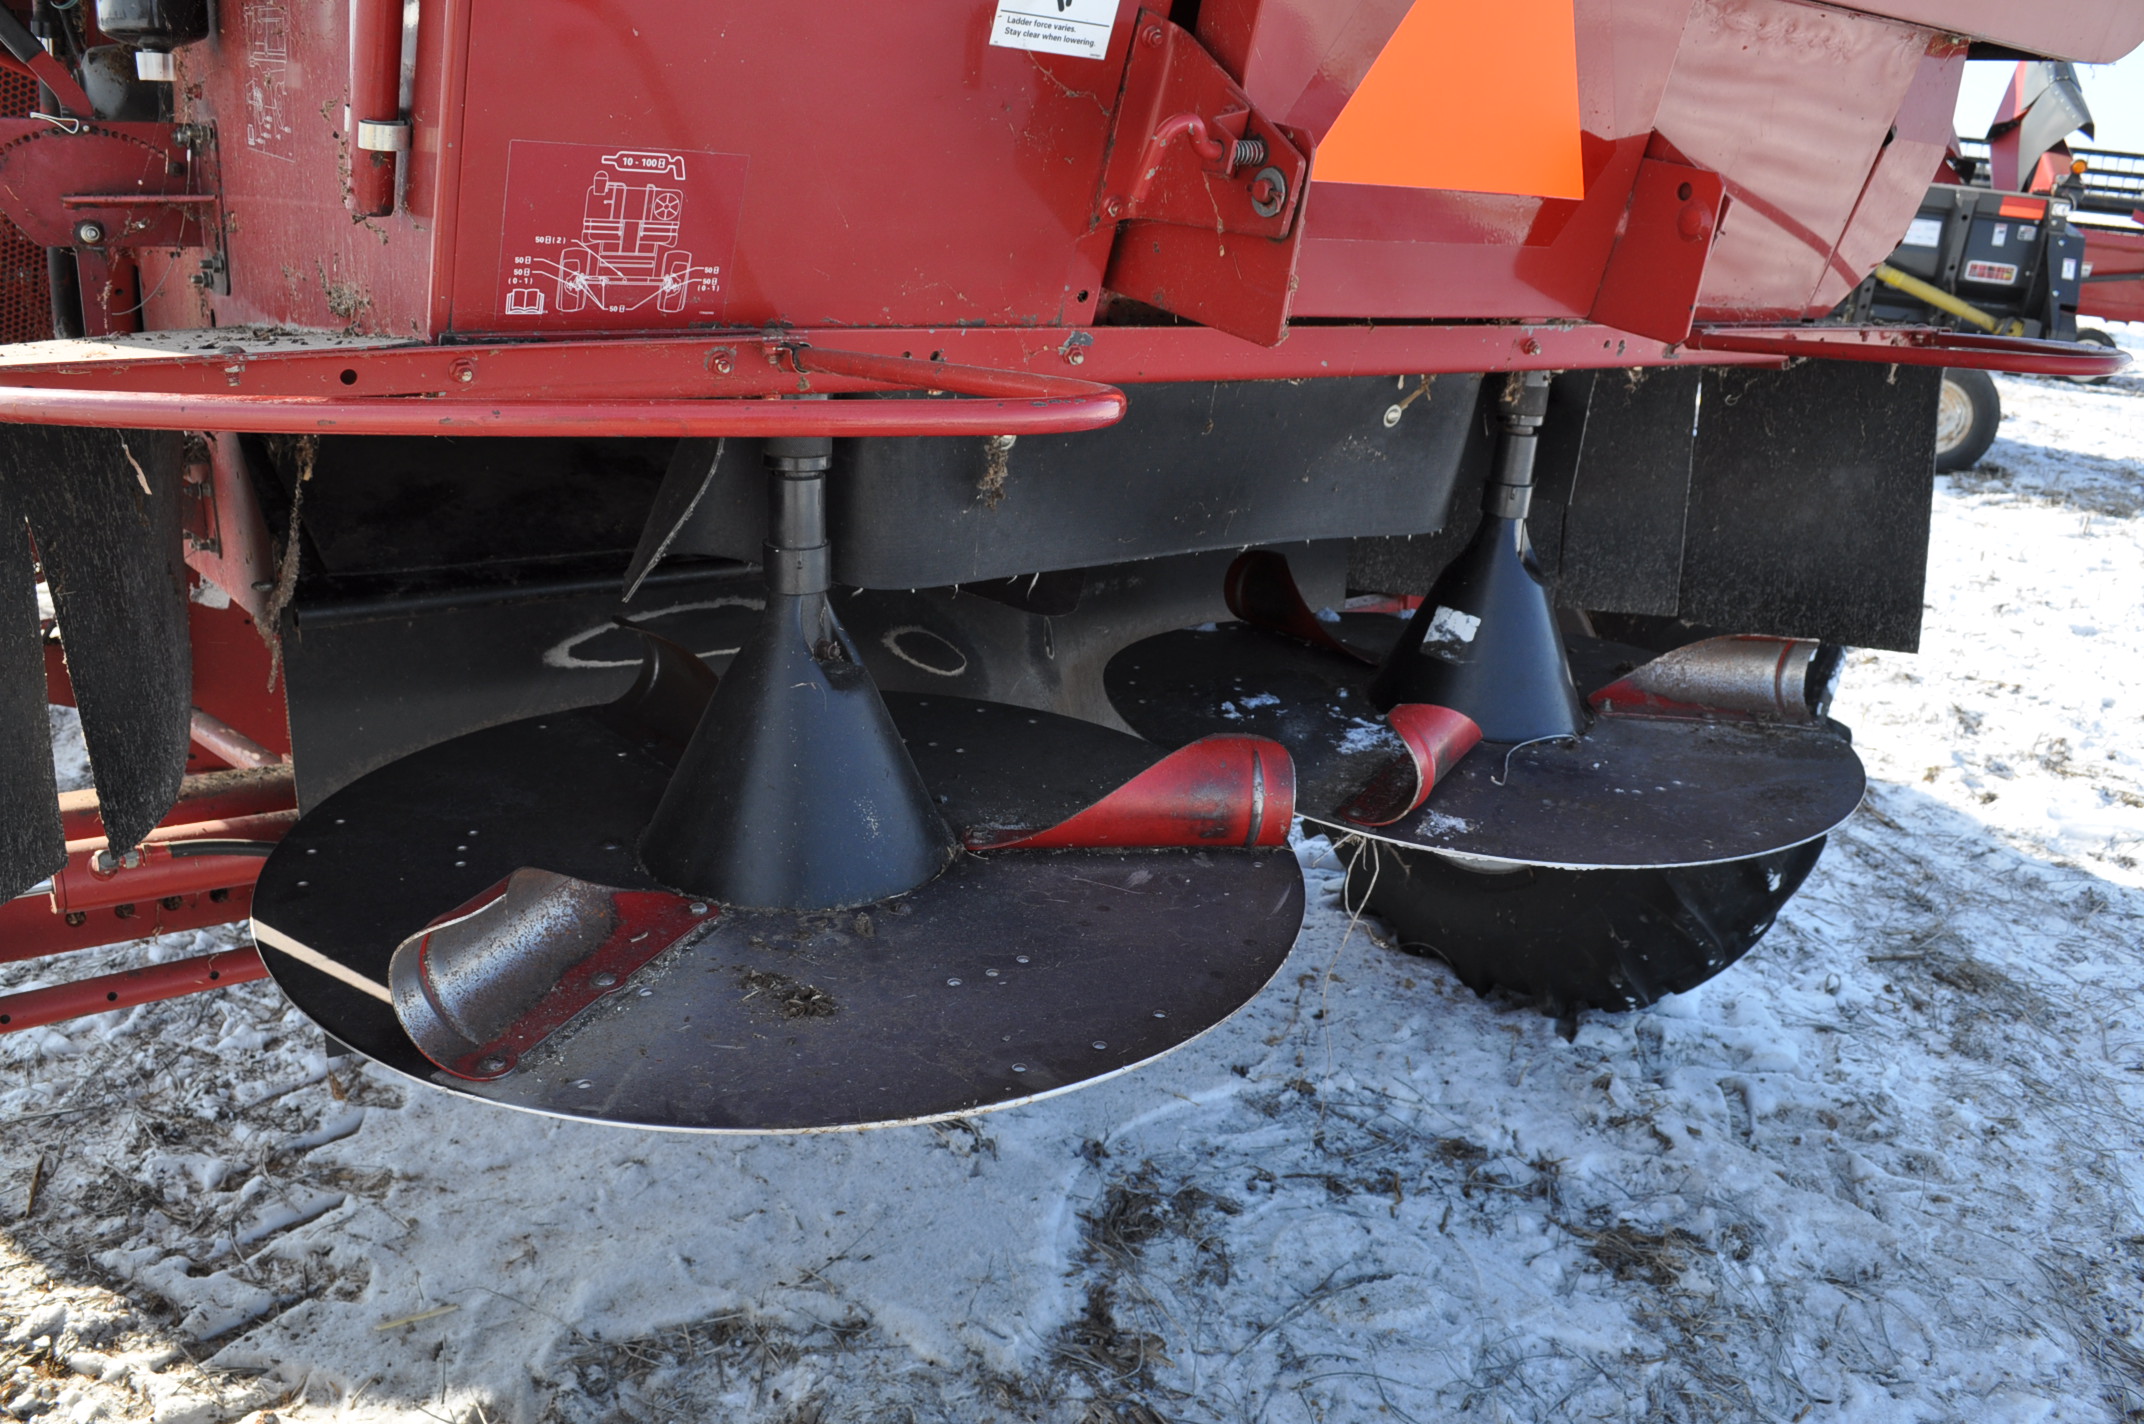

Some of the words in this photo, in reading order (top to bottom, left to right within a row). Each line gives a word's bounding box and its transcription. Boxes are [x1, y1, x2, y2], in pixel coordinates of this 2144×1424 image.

[1007, 16, 1032, 26] Ladder
[1033, 21, 1051, 29] force
[1053, 24, 1076, 33] varies.
[1004, 27, 1021, 37] Stay
[1022, 29, 1040, 39] clear
[1042, 33, 1062, 42] when
[1063, 36, 1096, 48] lowering.
[622, 157, 634, 166] 10
[642, 158, 658, 167] 100
